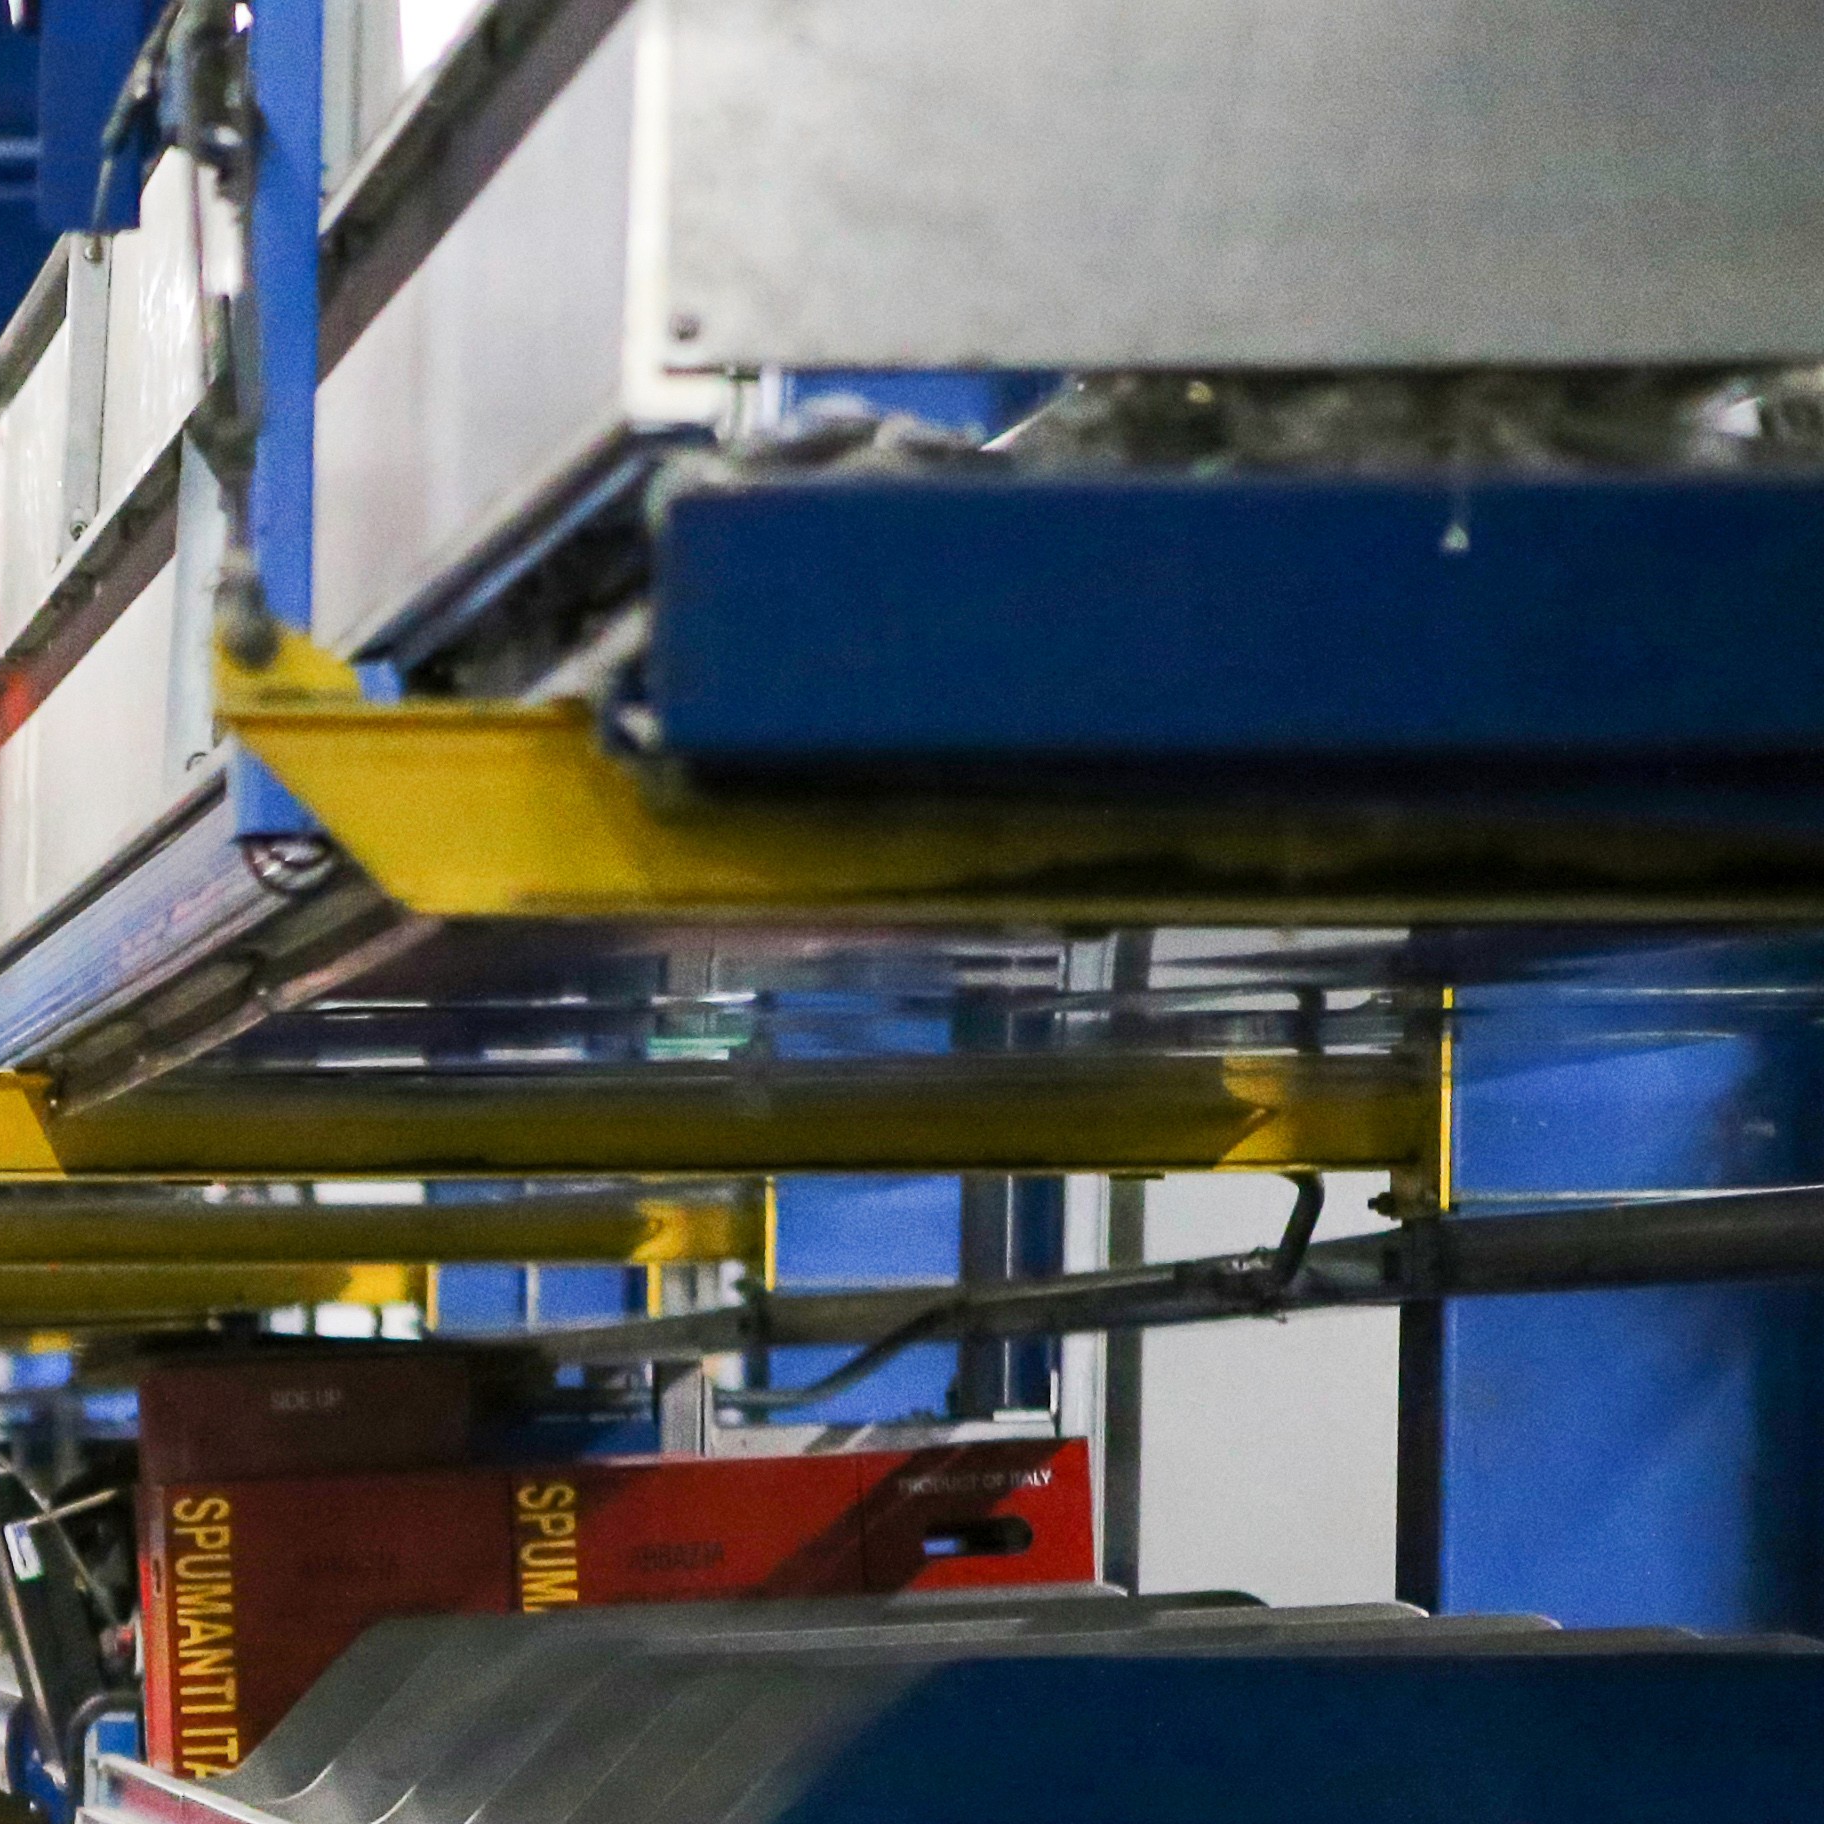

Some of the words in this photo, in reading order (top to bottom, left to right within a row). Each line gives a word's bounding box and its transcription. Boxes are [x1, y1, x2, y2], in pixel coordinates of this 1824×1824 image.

[983, 1472, 1007, 1491] OF
[1011, 1468, 1053, 1489] ITALY
[173, 1497, 237, 1714] SPUMANTI
[517, 1484, 579, 1613] SPUM
